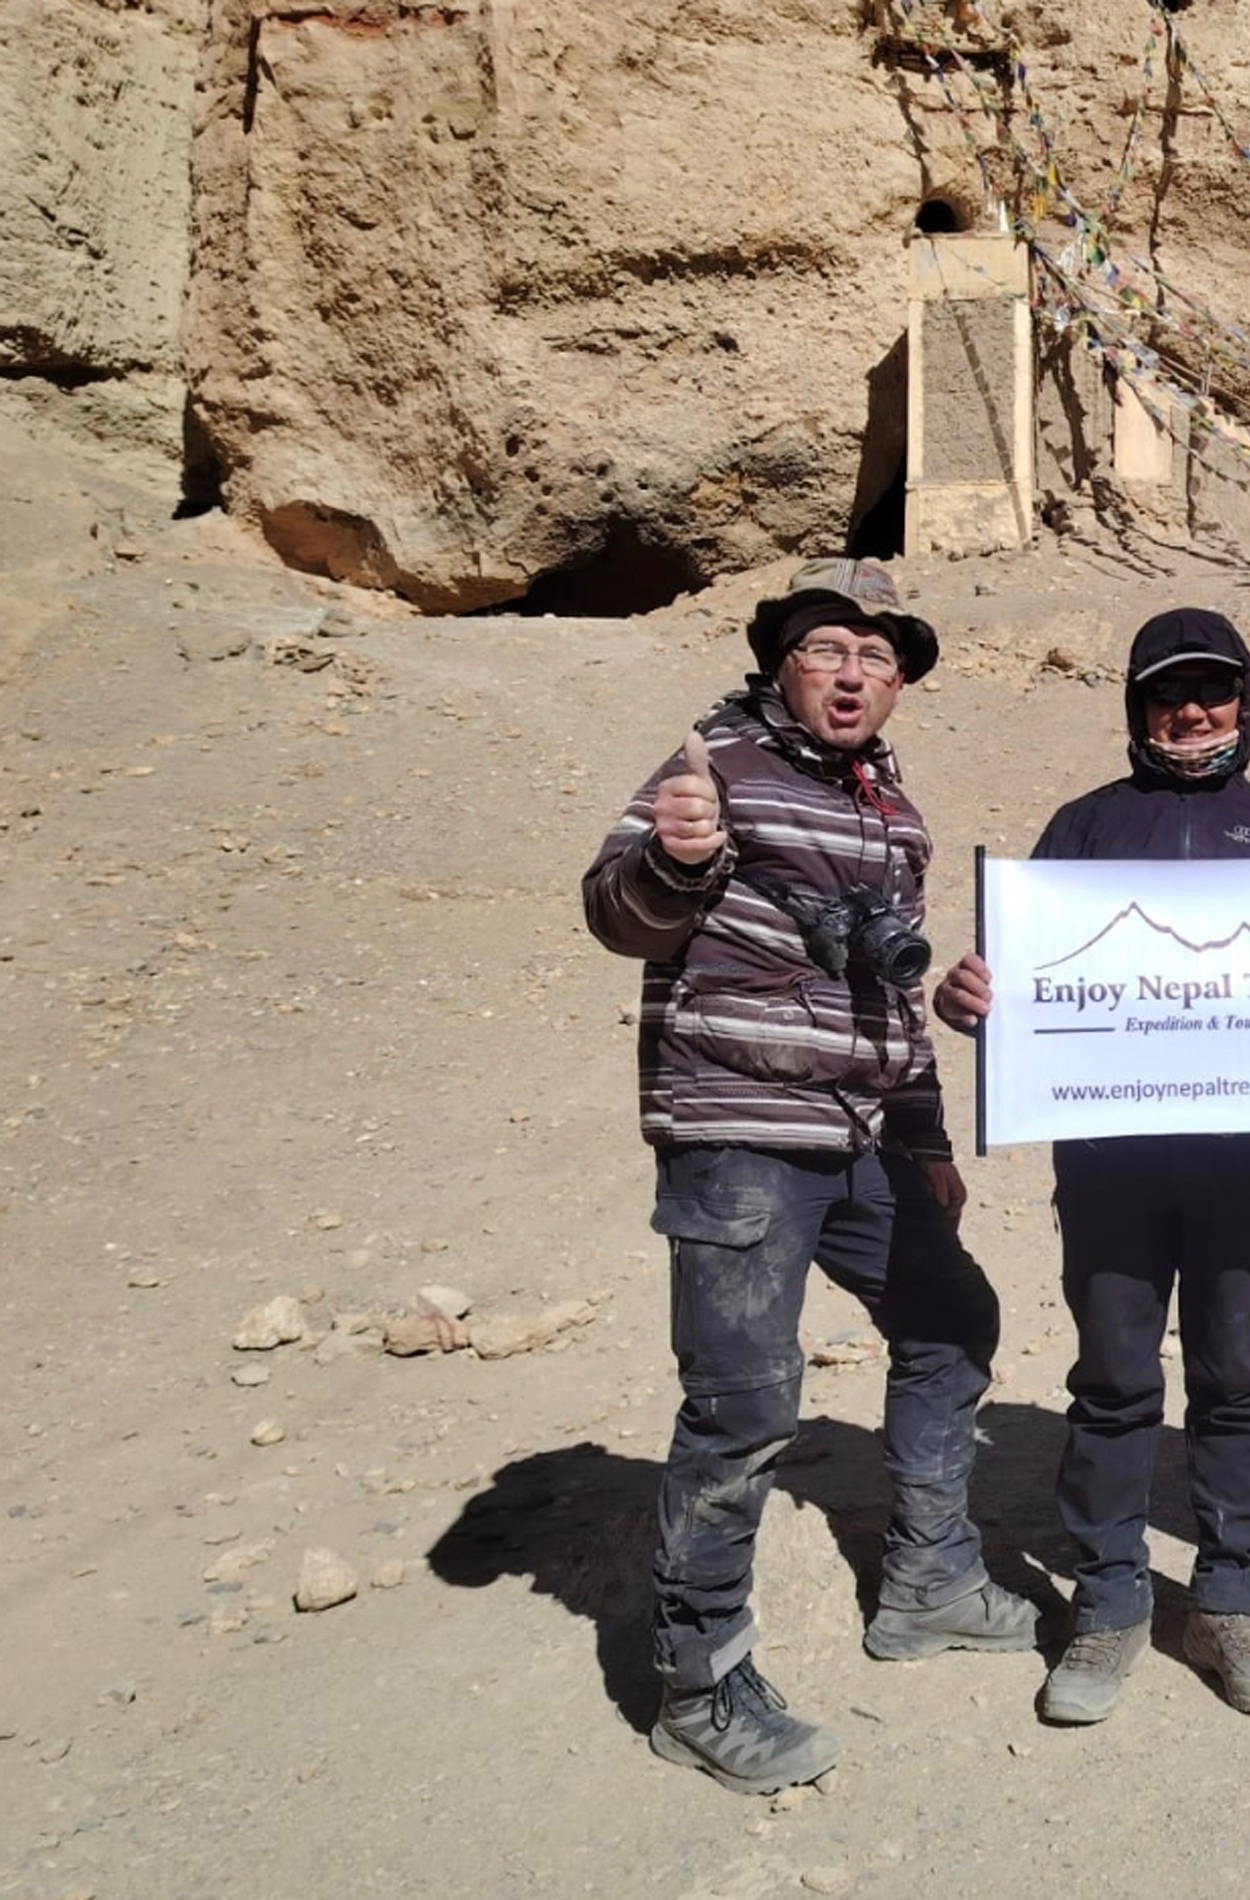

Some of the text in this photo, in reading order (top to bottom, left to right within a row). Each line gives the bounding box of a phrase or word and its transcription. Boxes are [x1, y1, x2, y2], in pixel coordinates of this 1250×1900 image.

[1033, 976, 1127, 1012] Enjoy
[1137, 973, 1232, 1010] Nepal
[1125, 1015, 1203, 1035] Expedition
[1207, 1015, 1220, 1030] &
